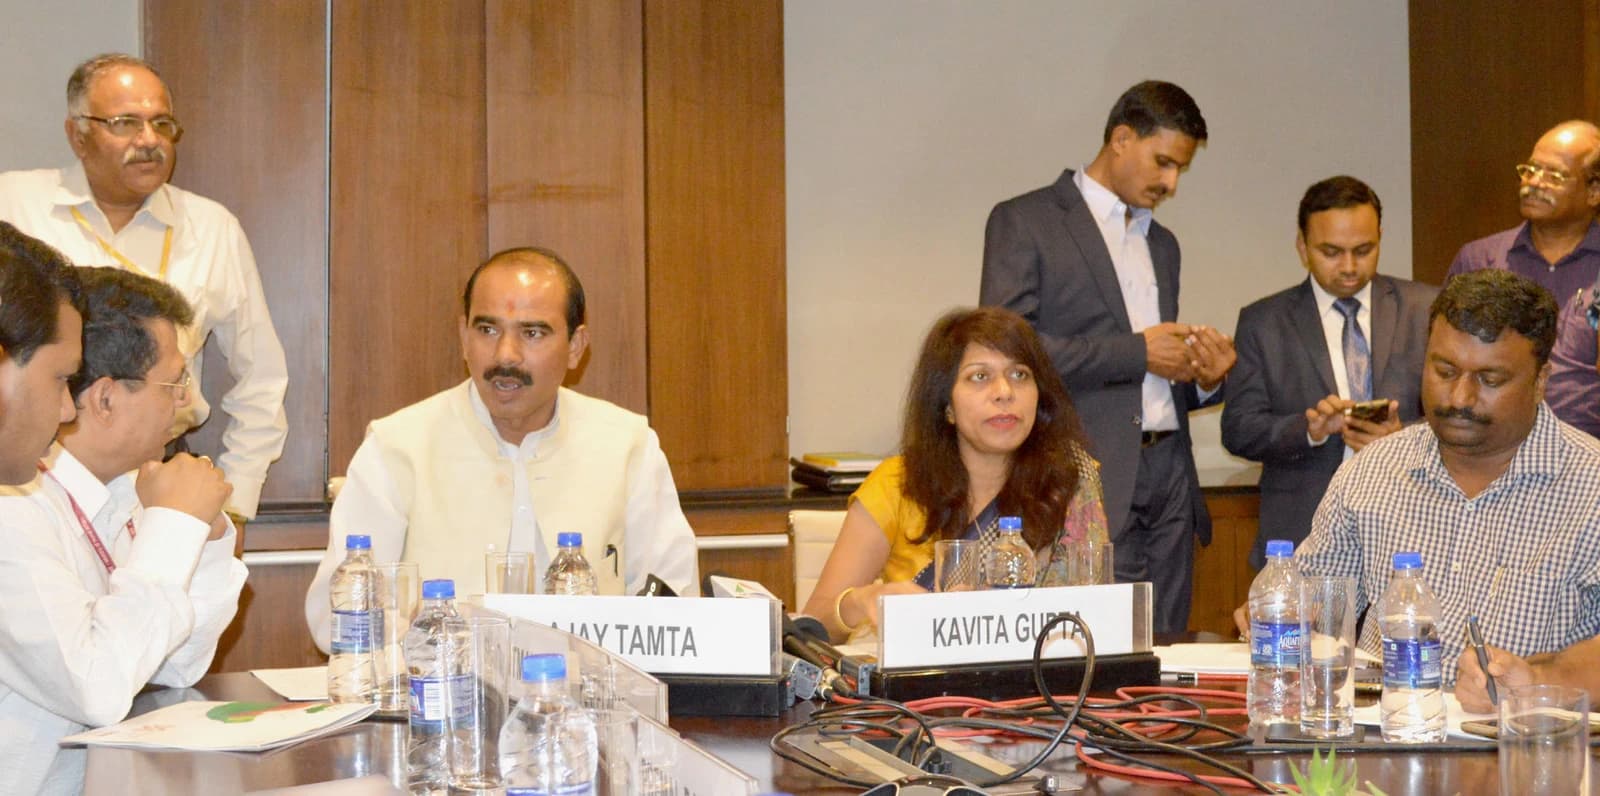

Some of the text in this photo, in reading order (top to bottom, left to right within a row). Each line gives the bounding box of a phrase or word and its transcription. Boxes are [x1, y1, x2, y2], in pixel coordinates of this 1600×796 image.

[614, 623, 698, 658] TAMTA
[932, 610, 1086, 647] KAVITA GUPTA
